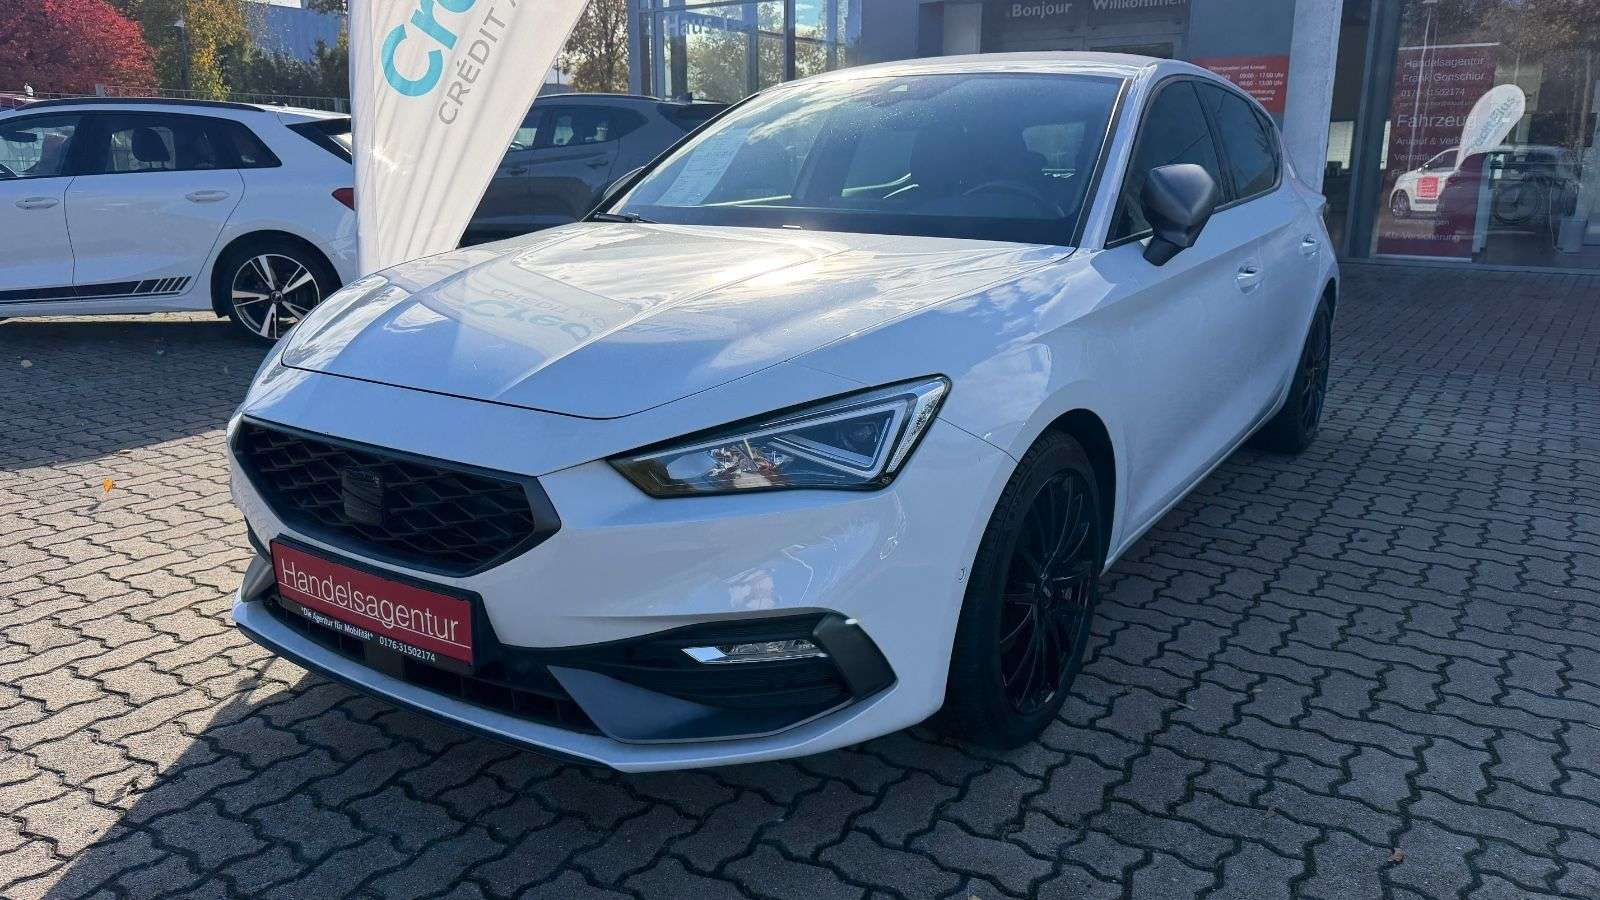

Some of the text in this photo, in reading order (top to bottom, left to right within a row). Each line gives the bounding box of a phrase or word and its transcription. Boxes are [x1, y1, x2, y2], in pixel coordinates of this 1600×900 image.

[1011, 2, 1073, 19] Bonjour
[1092, 0, 1187, 10] Willkommen
[439, 7, 506, 124] CRÉDIT
[1402, 74, 1431, 83] Frank
[281, 558, 459, 641] Handelsagentur
[312, 612, 333, 629] Agentur
[334, 619, 344, 632] für
[379, 636, 436, 662] 0176-31502174
